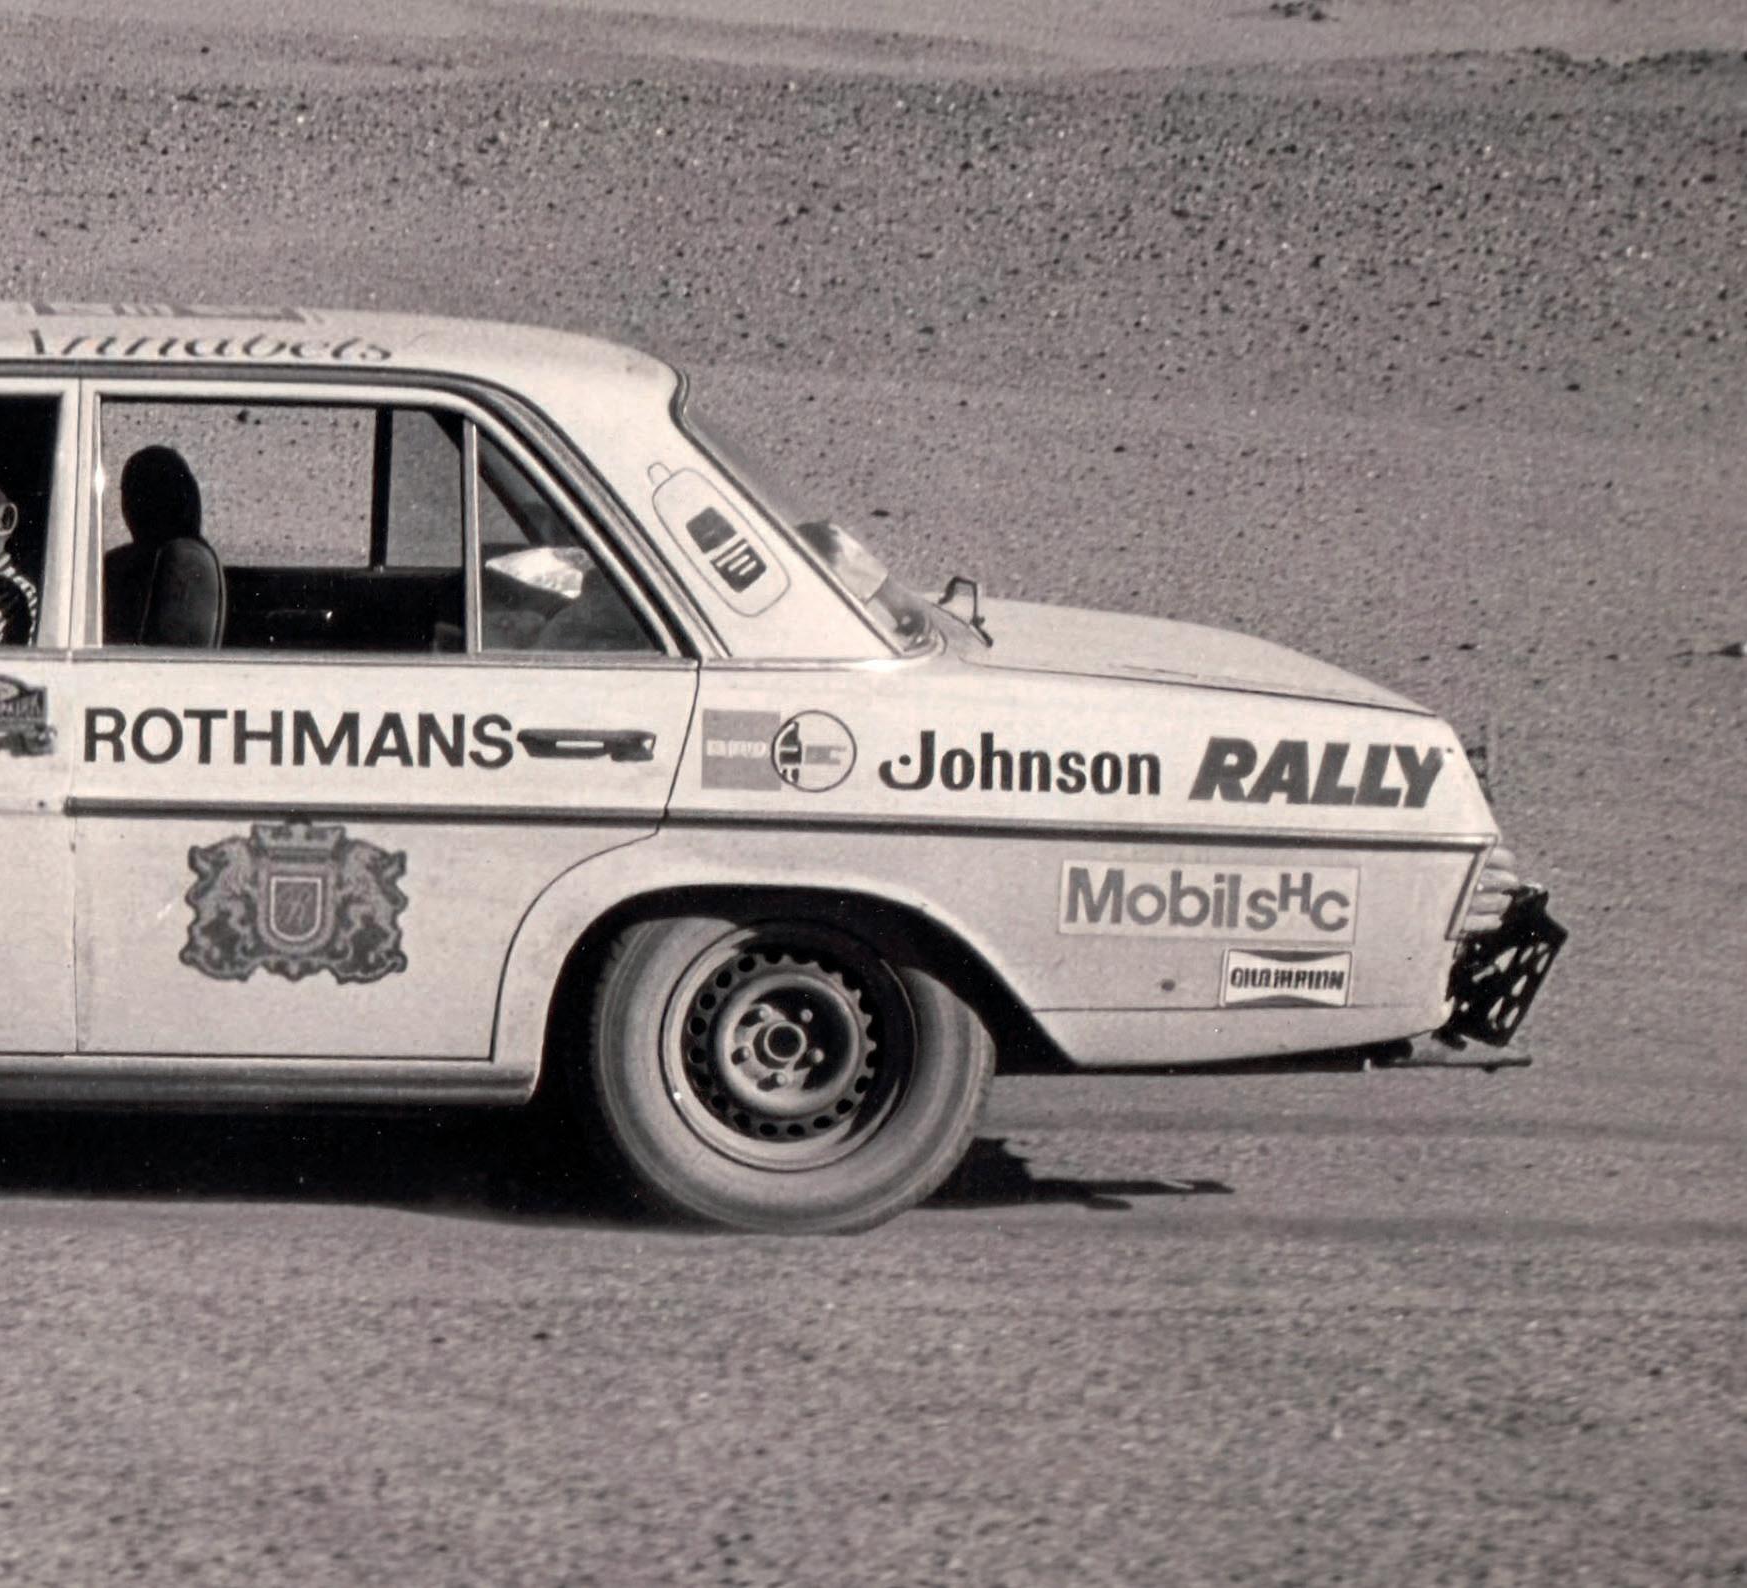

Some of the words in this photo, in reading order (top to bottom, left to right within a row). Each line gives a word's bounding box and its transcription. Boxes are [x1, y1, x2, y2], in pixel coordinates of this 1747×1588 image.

[83, 706, 515, 769] ROTHMANS
[878, 730, 1162, 795] Johnson
[1188, 735, 1451, 808] RALLY
